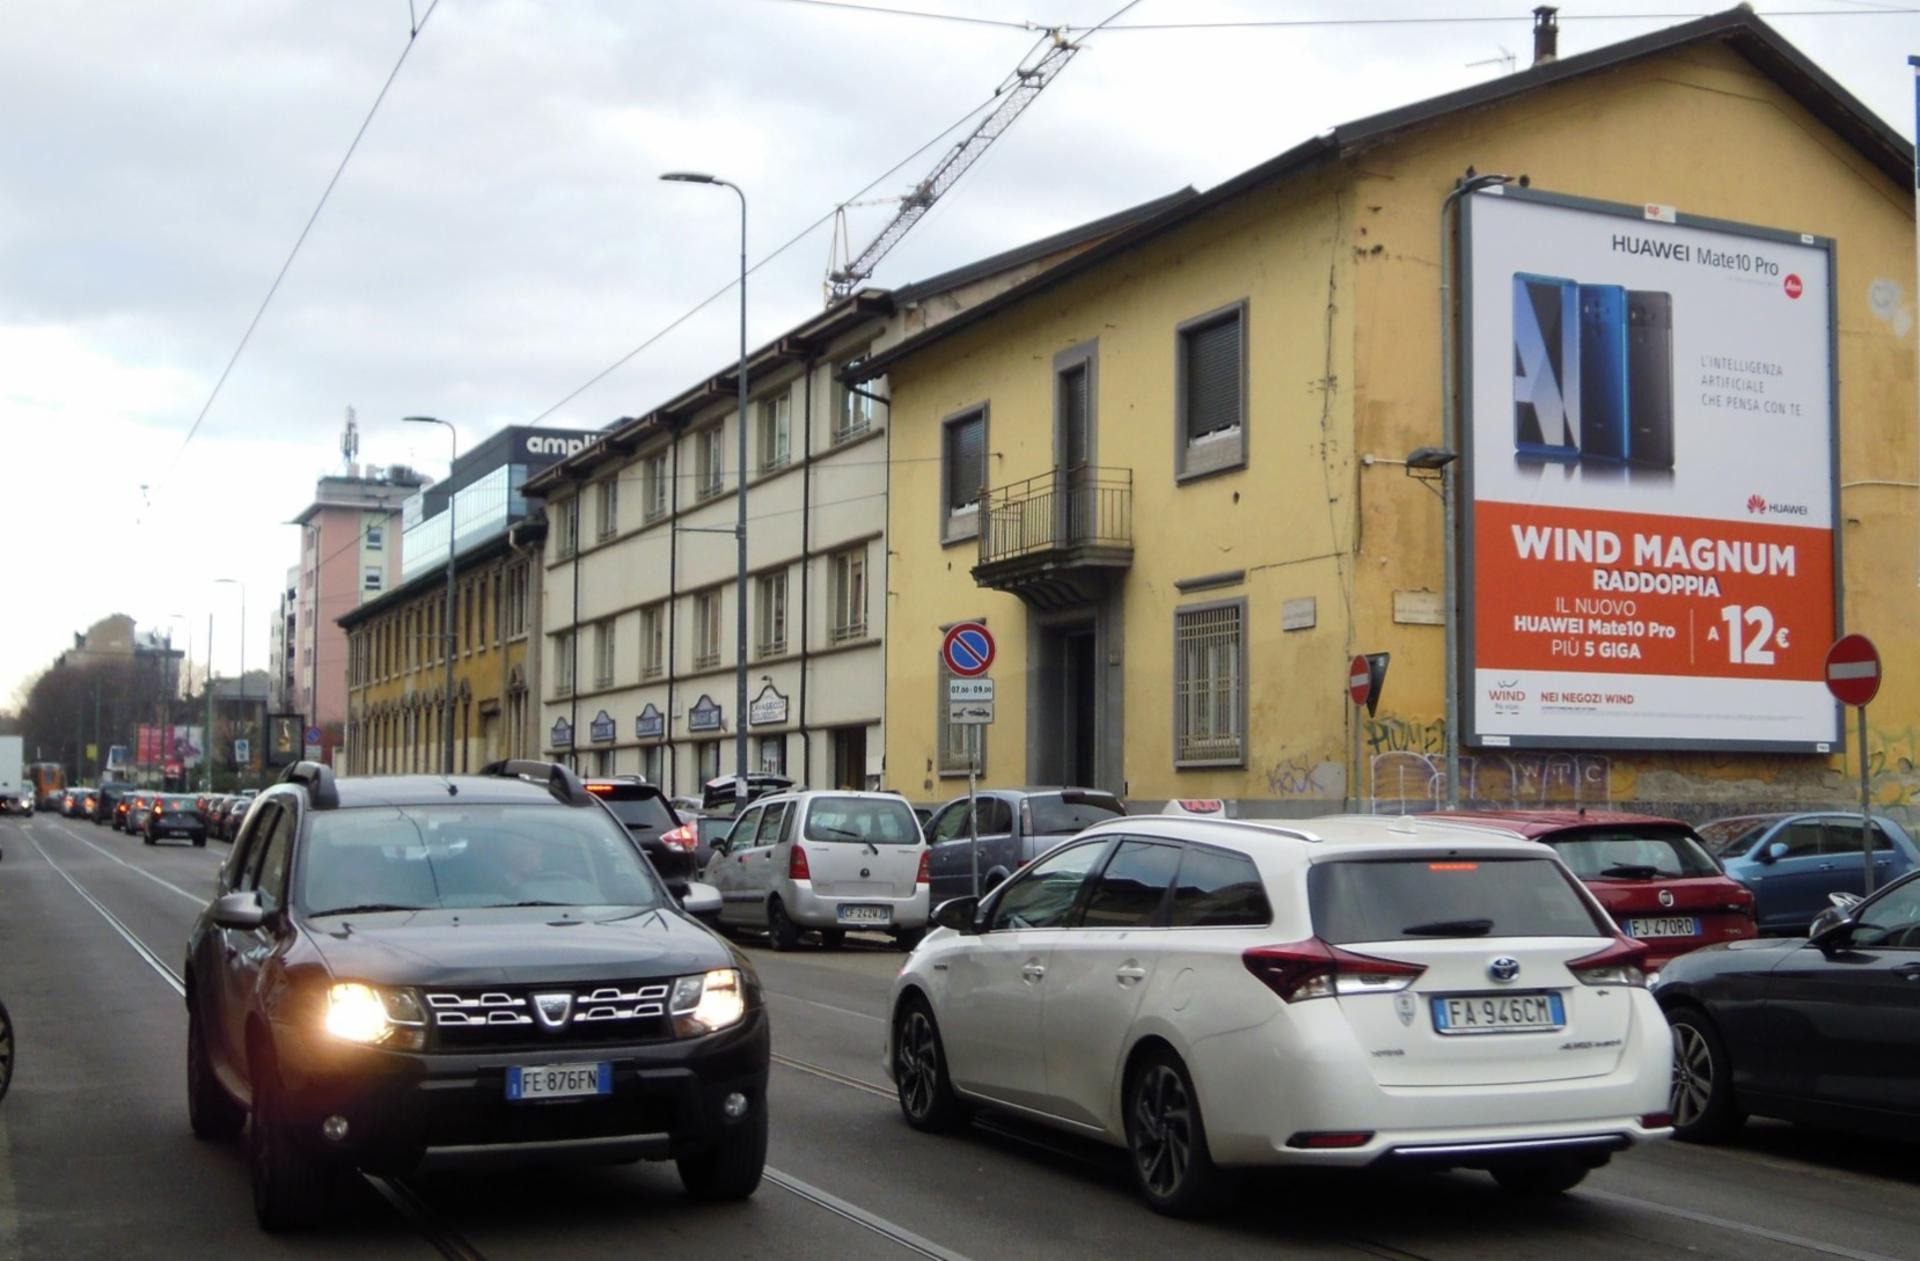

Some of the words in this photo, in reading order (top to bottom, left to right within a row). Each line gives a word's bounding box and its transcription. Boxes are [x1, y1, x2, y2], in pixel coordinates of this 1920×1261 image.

[1611, 234, 1690, 262] HUAWEI
[1697, 247, 1750, 272] Mate10
[1755, 256, 1779, 276] Pro
[1700, 355, 1784, 376] L'INTELLIGENZA
[1700, 374, 1765, 394] ARTIFICIALE
[1701, 393, 1722, 408] CHE
[1726, 396, 1759, 412] PENSA
[1763, 400, 1786, 415] CON
[526, 434, 600, 458] ampli
[1768, 504, 1808, 516] HUAWEI
[1511, 524, 1621, 564] WIND
[1634, 533, 1796, 577] MAGNUM
[1593, 569, 1721, 597] RADDOPPIA
[1556, 597, 1571, 613] IL
[1575, 598, 1637, 617] NUOVO
[1514, 616, 1584, 634] HUAWEI
[1588, 620, 1645, 638] Mate10
[1649, 621, 1676, 639] Pro
[1707, 626, 1720, 641] A
[1552, 636, 1579, 657] PIÙ
[1584, 642, 1595, 658] 5
[1599, 642, 1642, 659] GIGA
[1488, 689, 1526, 701] WIND
[1541, 691, 1559, 702] NEI
[1562, 692, 1602, 704] NEGOZI
[1605, 693, 1635, 705] WIND
[1450, 1001, 1477, 1027] FA
[1485, 998, 1549, 1026] 946CM
